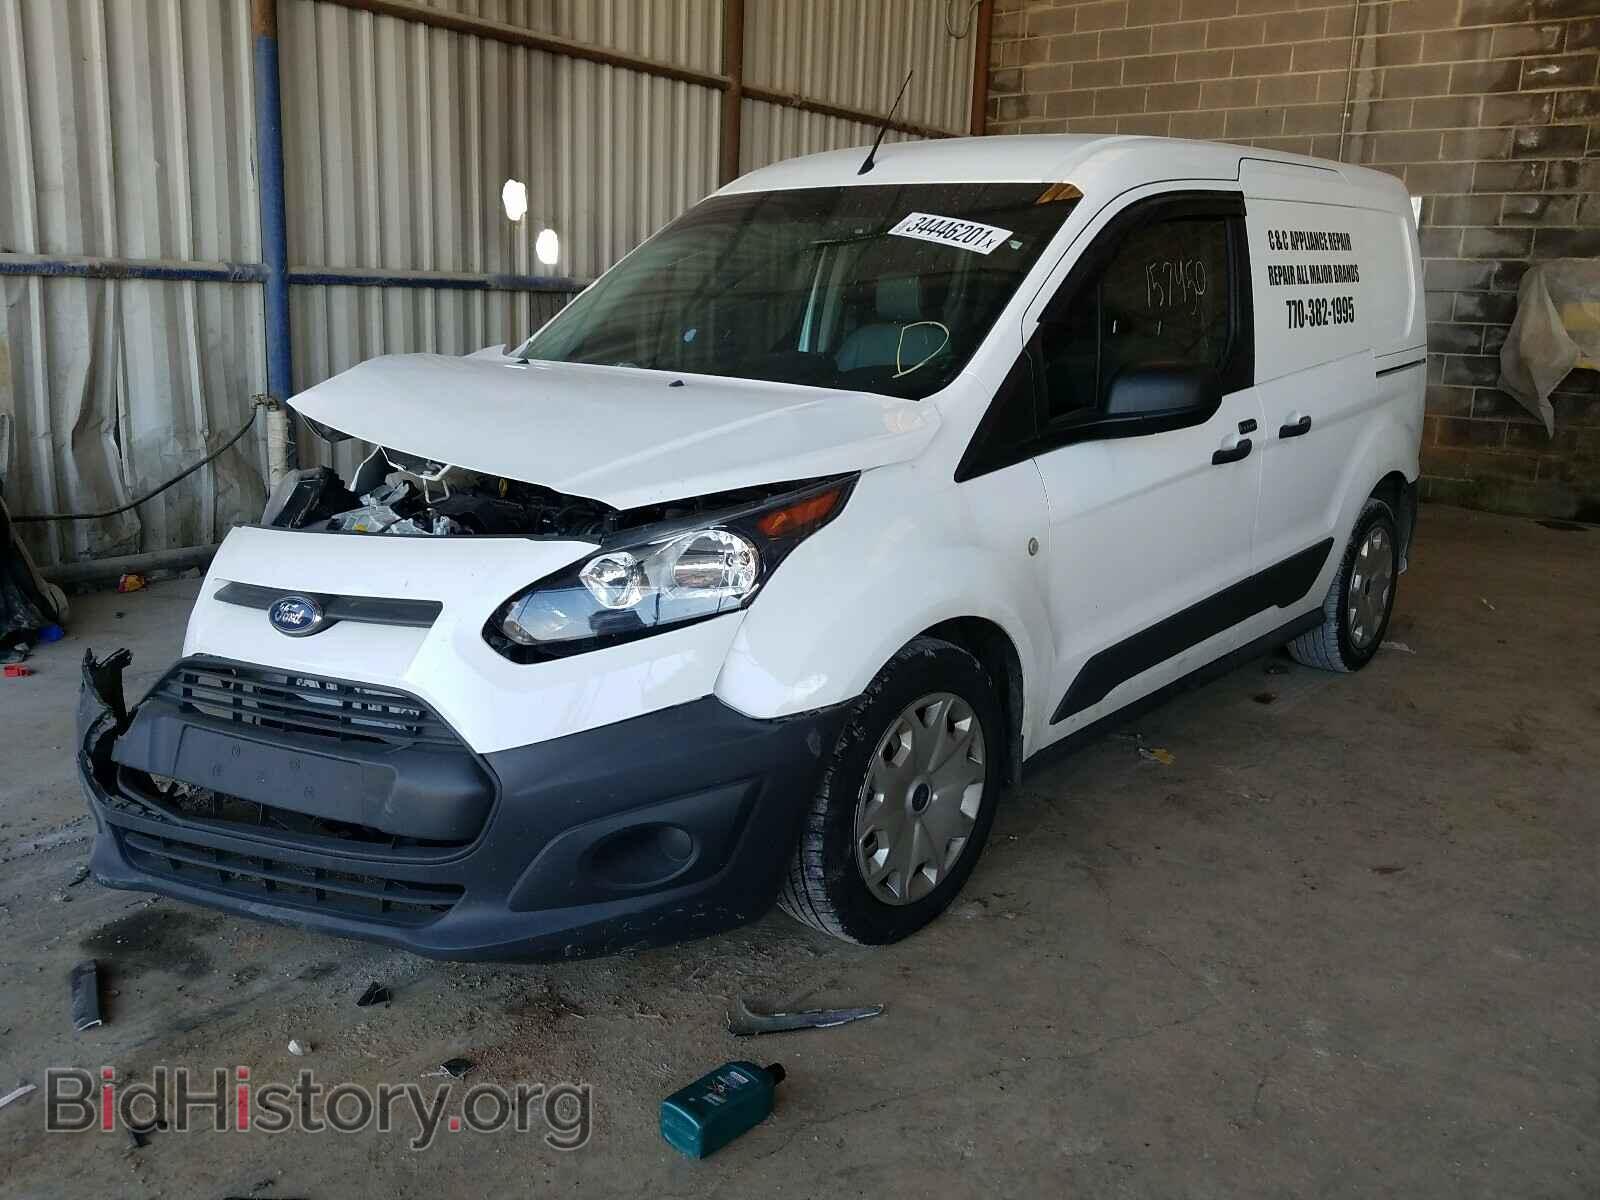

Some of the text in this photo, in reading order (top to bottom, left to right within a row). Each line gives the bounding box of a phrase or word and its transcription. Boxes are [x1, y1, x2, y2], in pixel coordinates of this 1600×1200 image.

[1289, 230, 1328, 251] APPLIANCE
[1328, 232, 1352, 251] REPAIR
[1268, 264, 1360, 286] REPAIR ALL MAJOR BRANDS
[1286, 296, 1355, 329] 770-382-1995
[274, 602, 306, 625] Ford
